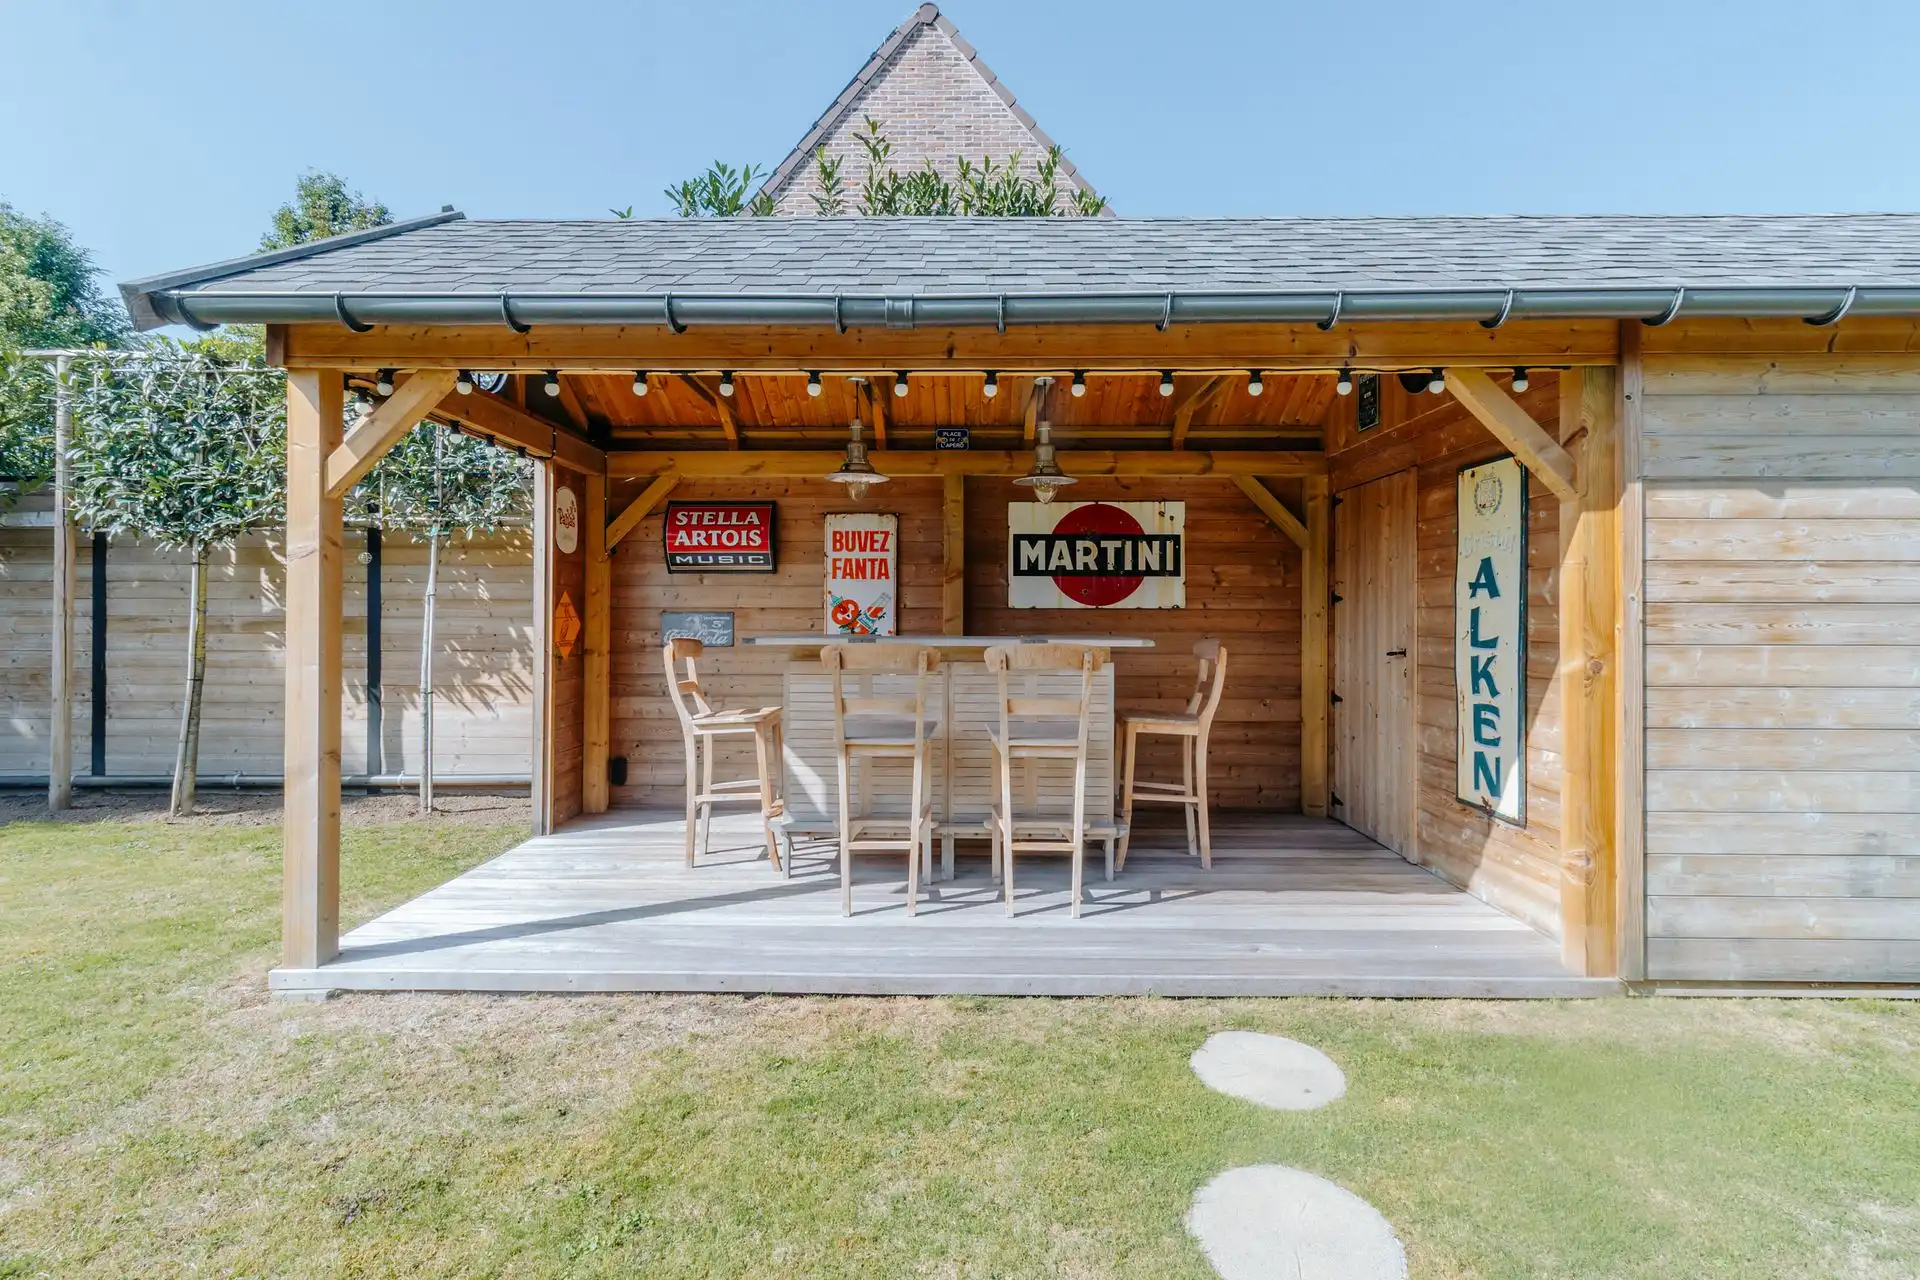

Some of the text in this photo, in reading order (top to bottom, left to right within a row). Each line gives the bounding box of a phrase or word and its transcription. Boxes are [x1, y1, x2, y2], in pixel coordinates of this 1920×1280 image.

[675, 511, 761, 526] STELLA
[674, 529, 762, 547] ARTOIS
[832, 530, 891, 552] BUVEZ
[675, 555, 765, 564] MUSIC
[1019, 539, 1174, 571] MARTINI
[831, 557, 890, 580] FANTA
[1468, 556, 1501, 798] ALKEN
